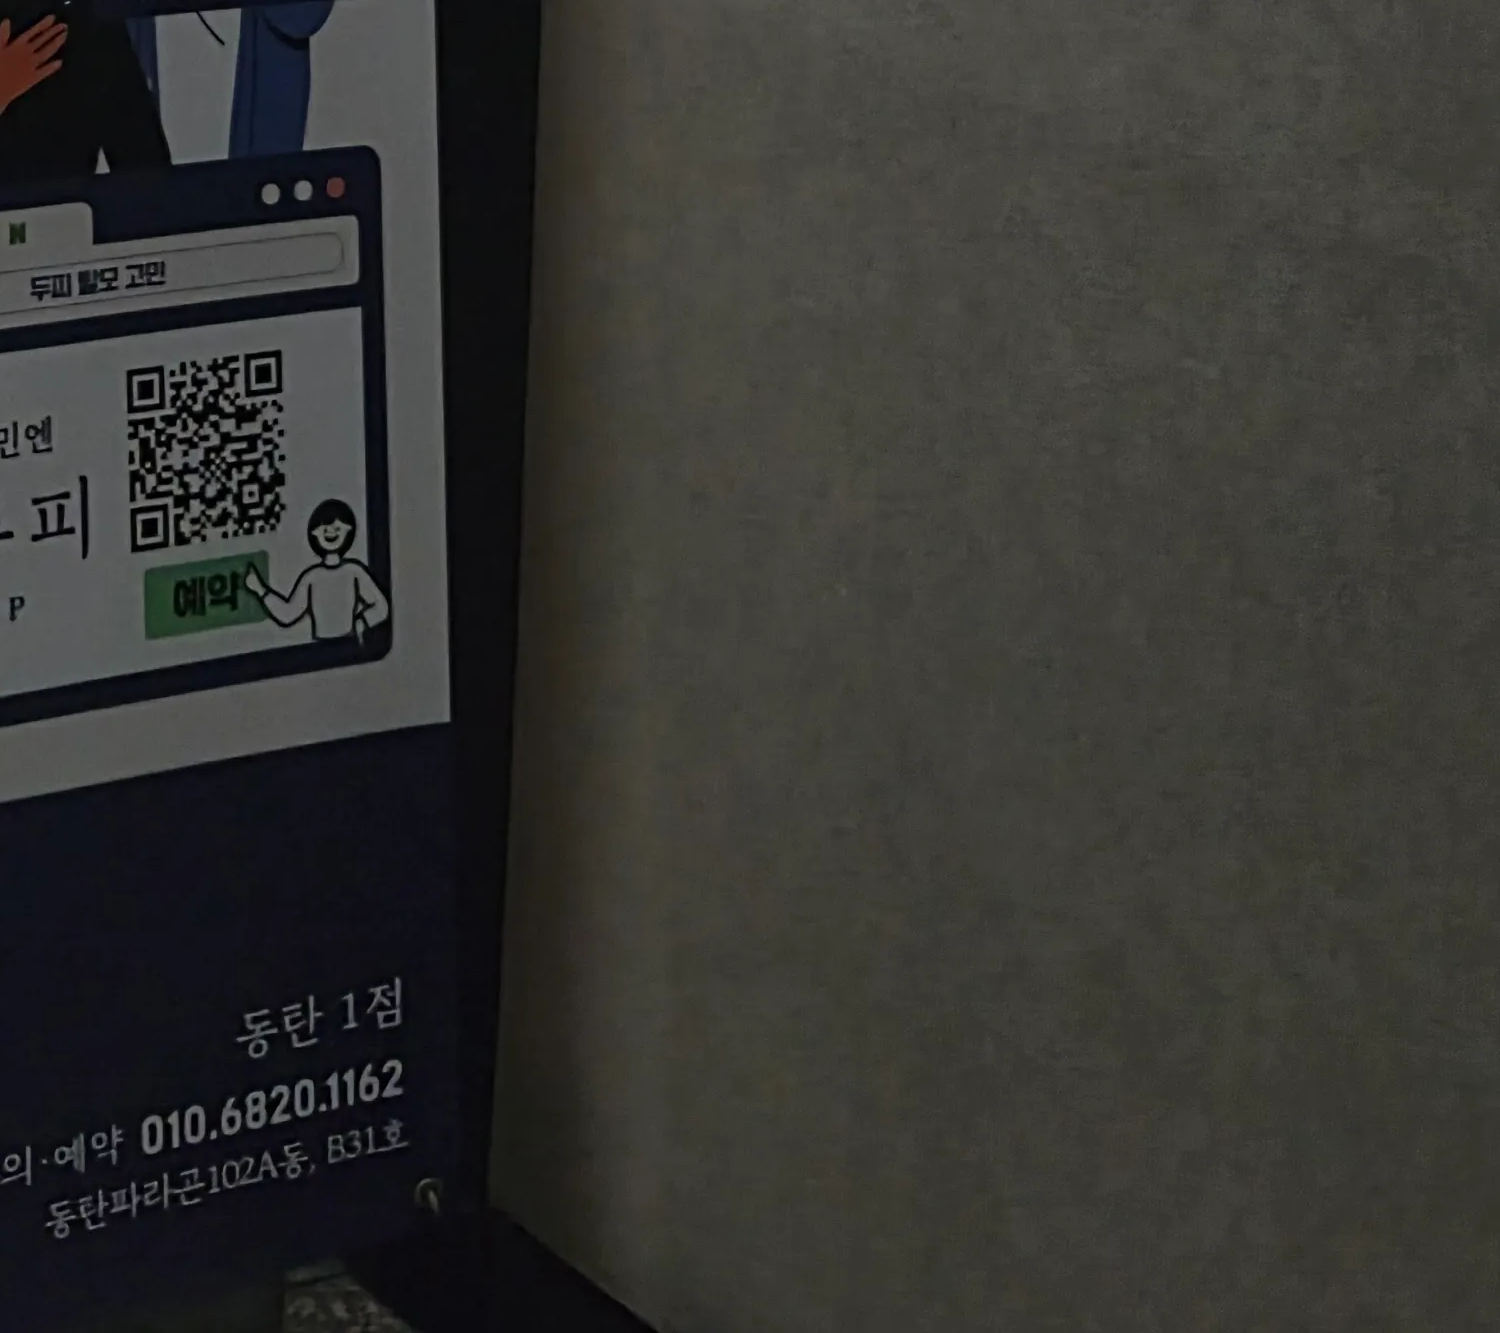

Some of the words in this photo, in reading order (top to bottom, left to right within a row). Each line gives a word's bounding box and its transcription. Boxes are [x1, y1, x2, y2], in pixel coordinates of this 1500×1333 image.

[30, 273, 72, 301] 두피
[78, 266, 118, 295] 탈모
[125, 261, 166, 289] 고민
[173, 570, 243, 618] 예약
[237, 995, 324, 1059] 동탄
[342, 977, 402, 1029] 1점
[141, 1059, 403, 1155] 010.6820.1162
[328, 1120, 409, 1163] B31호
